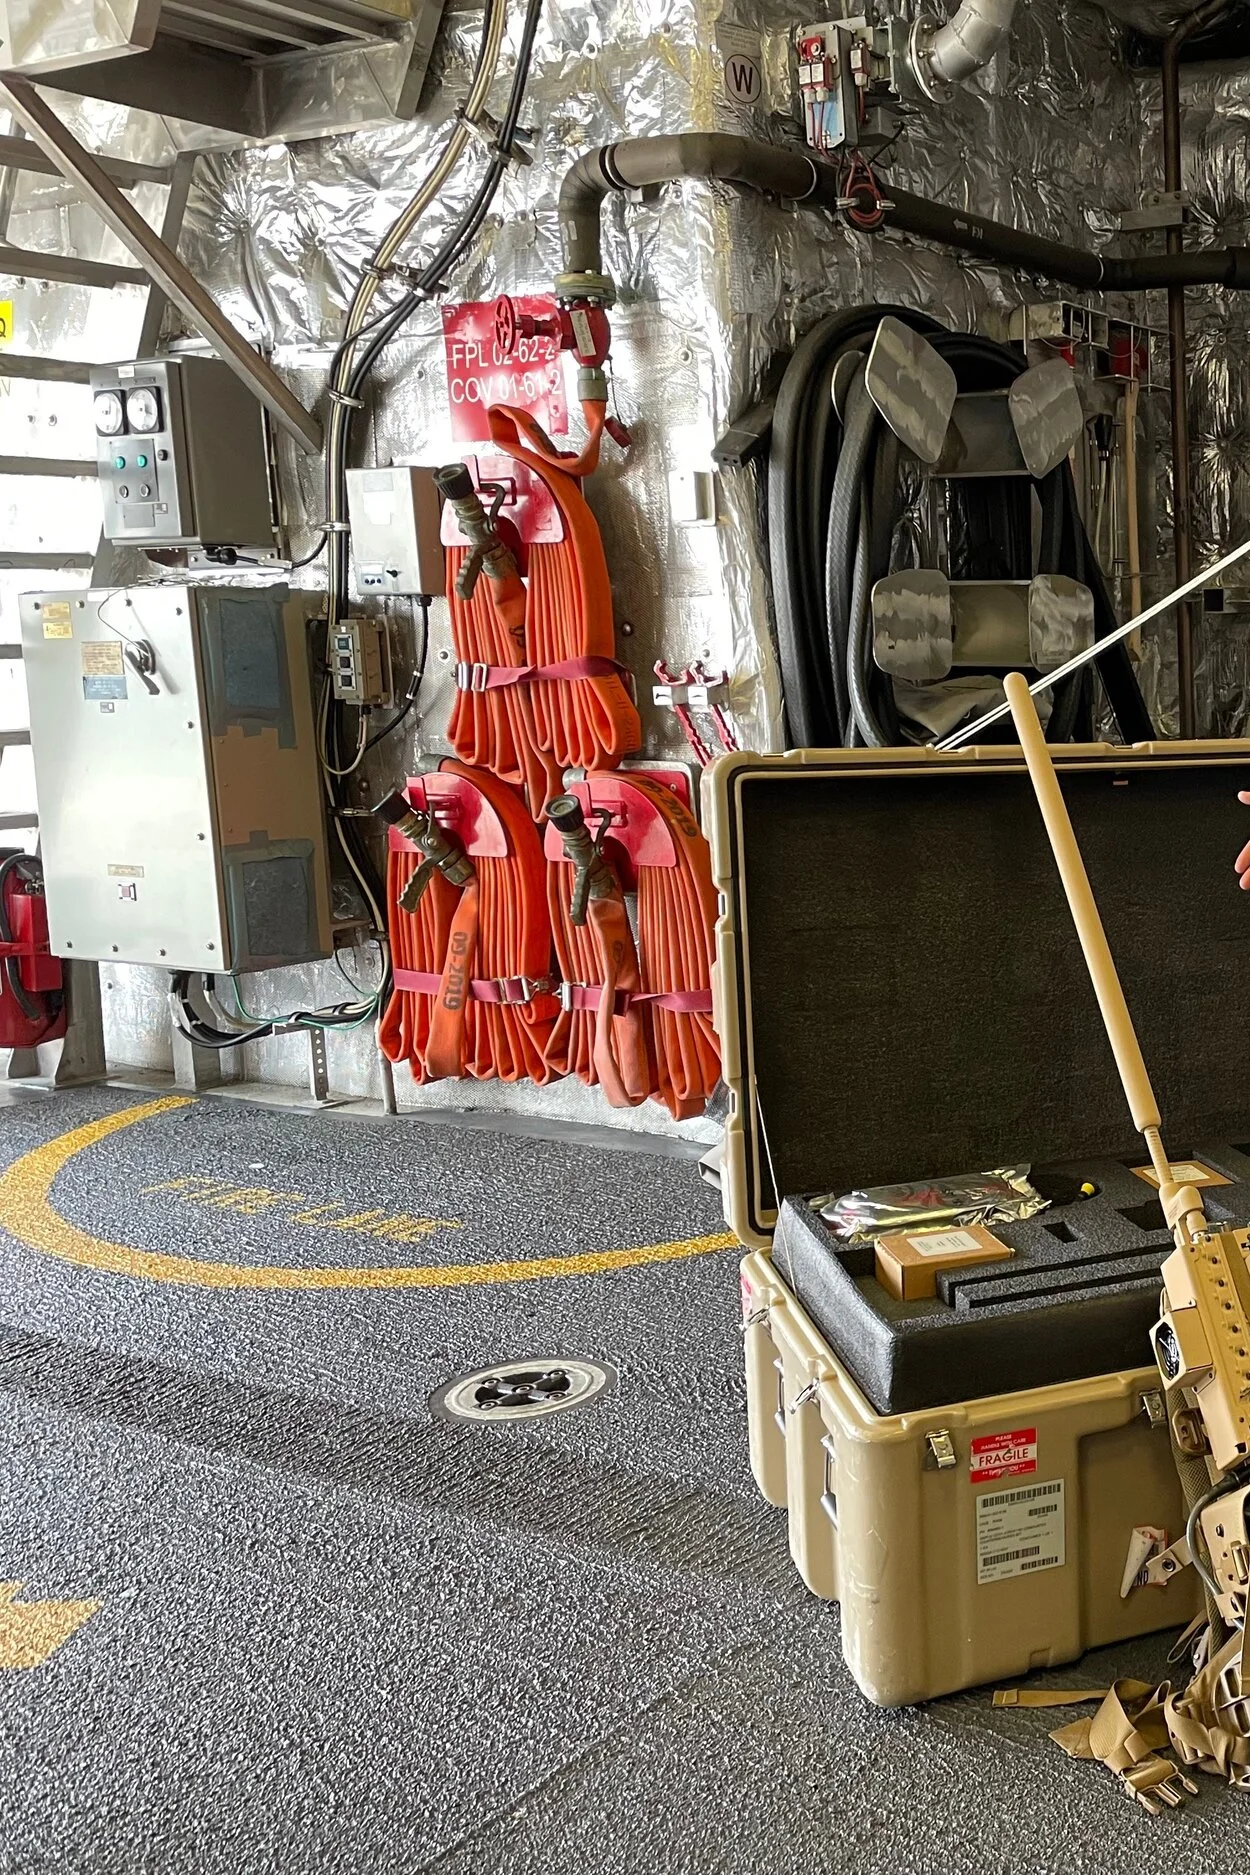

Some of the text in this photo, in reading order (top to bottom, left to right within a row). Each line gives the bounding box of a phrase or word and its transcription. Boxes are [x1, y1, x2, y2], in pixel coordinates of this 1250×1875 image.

[731, 62, 754, 95] W
[452, 343, 489, 369] FPL
[451, 375, 495, 403] COV
[979, 1447, 1029, 1467] FRAGILE
